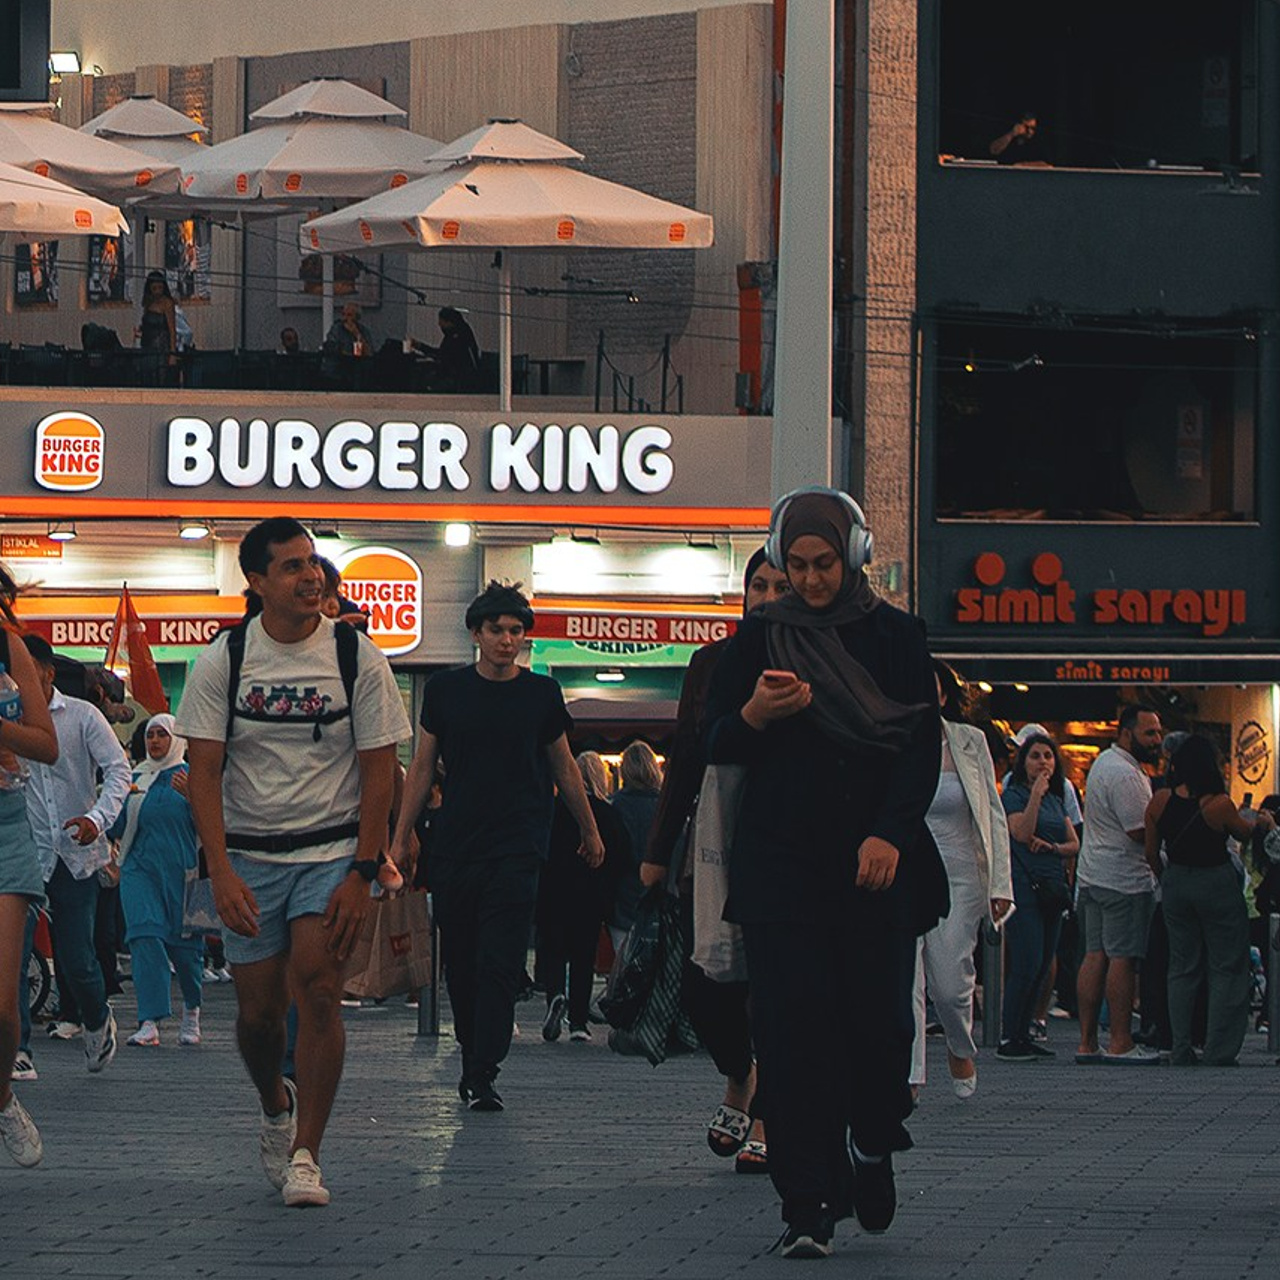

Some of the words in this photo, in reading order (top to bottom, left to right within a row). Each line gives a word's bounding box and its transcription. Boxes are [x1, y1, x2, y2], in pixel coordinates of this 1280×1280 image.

[42, 438, 100, 452] BURGER
[168, 417, 470, 490] BURGER
[490, 422, 674, 493] KING
[42, 453, 100, 472] KING
[338, 582, 417, 602] BURGER
[958, 552, 1076, 623] simit
[1093, 589, 1246, 636] sarayı
[51, 621, 146, 644] BURG
[160, 621, 221, 643] KING
[566, 616, 657, 639] BURGER
[670, 621, 728, 642] KING
[1056, 661, 1103, 679] simit
[1111, 666, 1170, 682] sarayı
